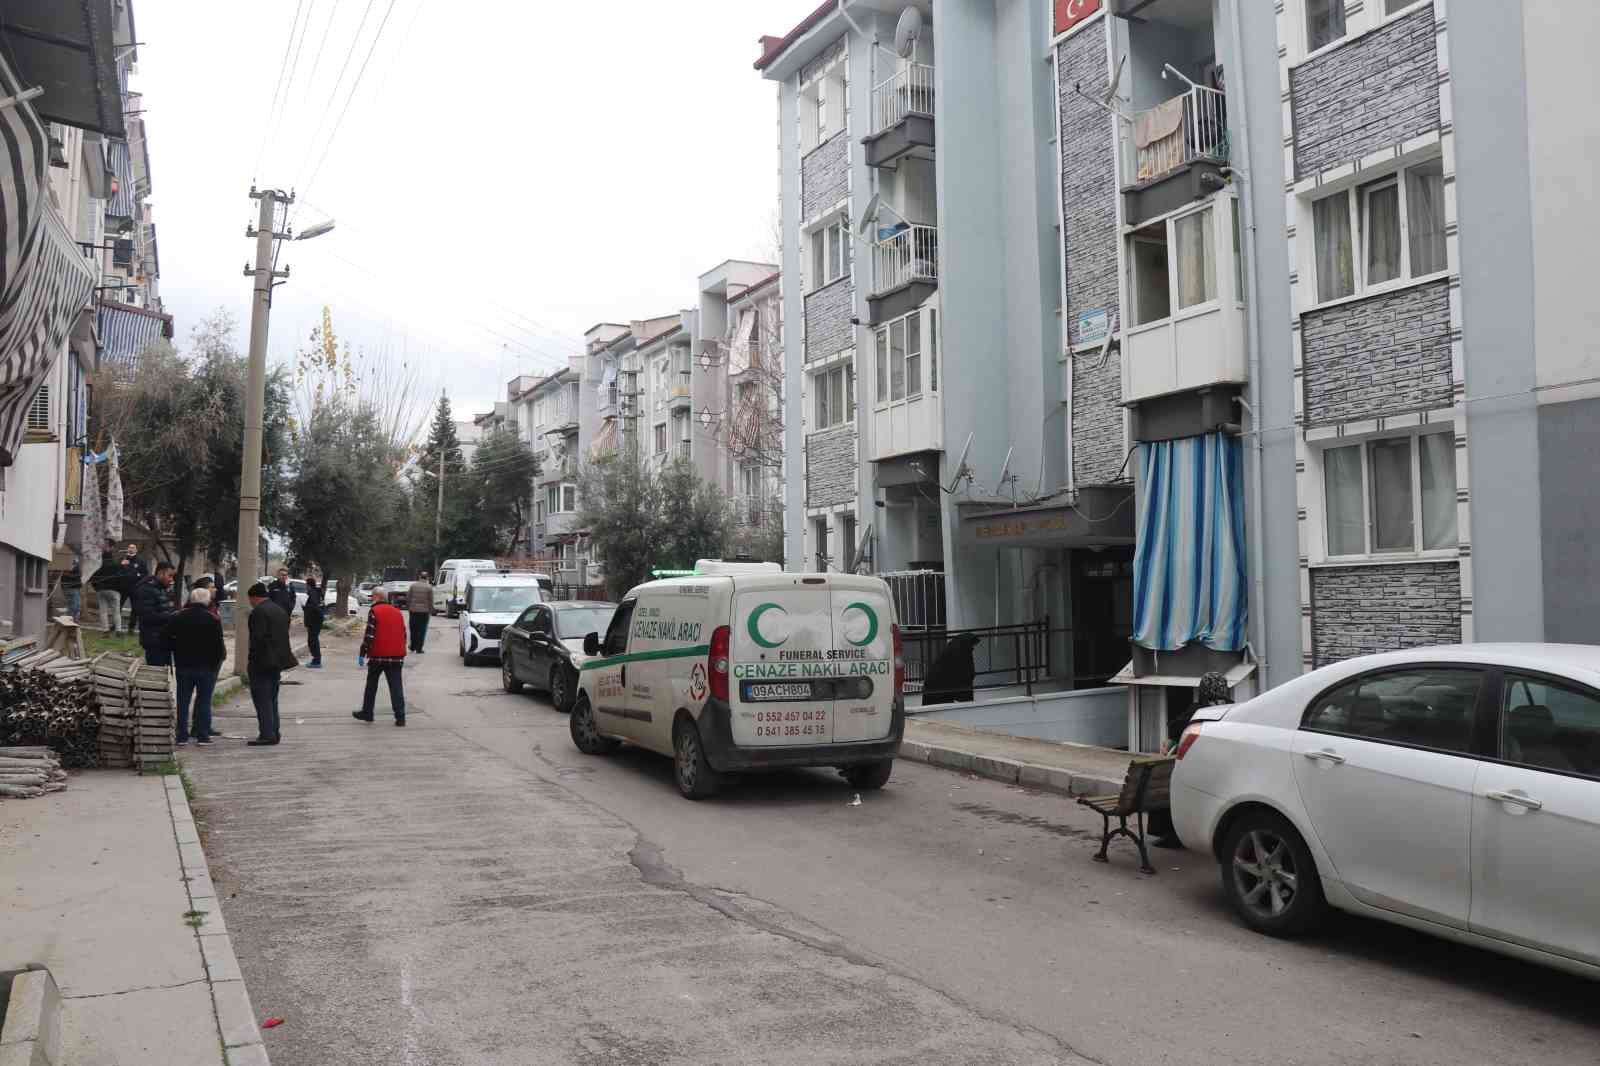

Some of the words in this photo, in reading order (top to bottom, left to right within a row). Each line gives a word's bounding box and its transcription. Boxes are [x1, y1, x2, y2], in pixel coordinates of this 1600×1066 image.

[779, 650, 824, 660] FUNERAL
[826, 649, 865, 660] SERVICE
[733, 663, 797, 678] CENAZE
[850, 662, 890, 675] ARACI
[757, 712, 763, 721] 0
[815, 710, 826, 721] 22
[757, 727, 763, 736] 0
